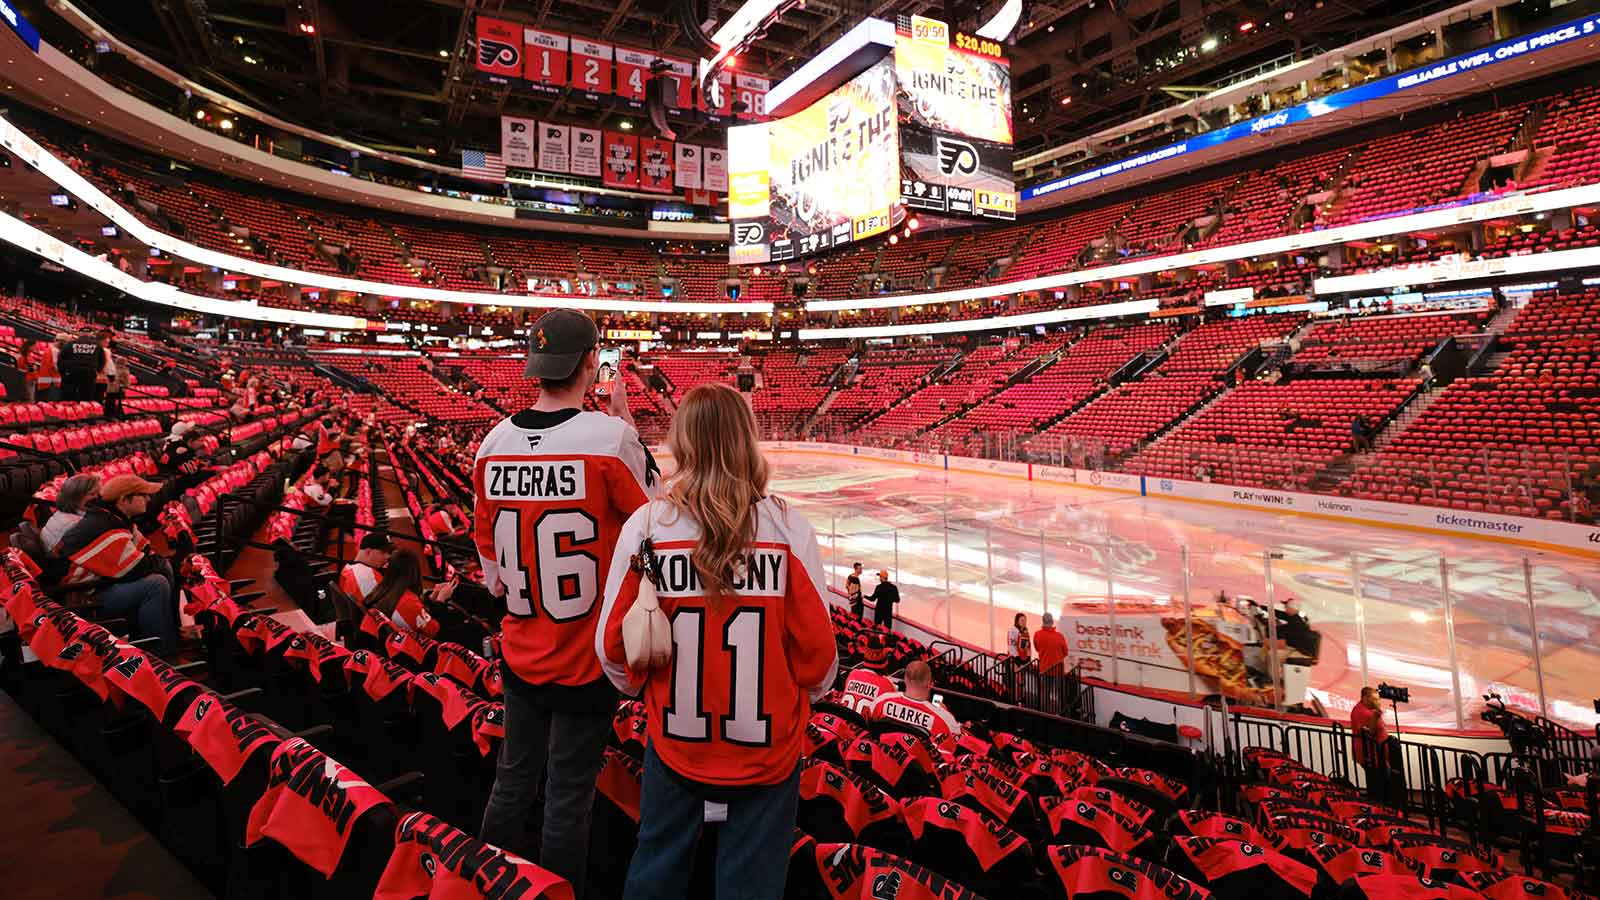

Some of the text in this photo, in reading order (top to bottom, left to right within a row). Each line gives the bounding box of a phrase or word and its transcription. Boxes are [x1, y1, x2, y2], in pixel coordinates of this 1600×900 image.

[955, 31, 1002, 58] $20,000
[1397, 62, 1457, 89] RELIABLE
[1494, 40, 1529, 59] ONE
[1529, 26, 1581, 50] PRICE.
[1583, 20, 1595, 34] 5
[541, 50, 551, 77] 1
[584, 58, 601, 85] 2
[628, 68, 643, 93] 4
[971, 83, 997, 101] THE
[858, 105, 891, 151] THE
[1251, 112, 1289, 132] xfinity
[489, 465, 577, 498] ZEGRAS
[1233, 490, 1254, 500] PLAY
[1263, 494, 1284, 505] WIN!
[1318, 500, 1353, 513] Holman
[1436, 512, 1523, 534] ticketmaster
[492, 507, 599, 624] 46
[1075, 620, 1111, 637] best
[662, 606, 773, 748] 11
[846, 680, 878, 698] GIROUX
[885, 702, 931, 728] CLARKE
